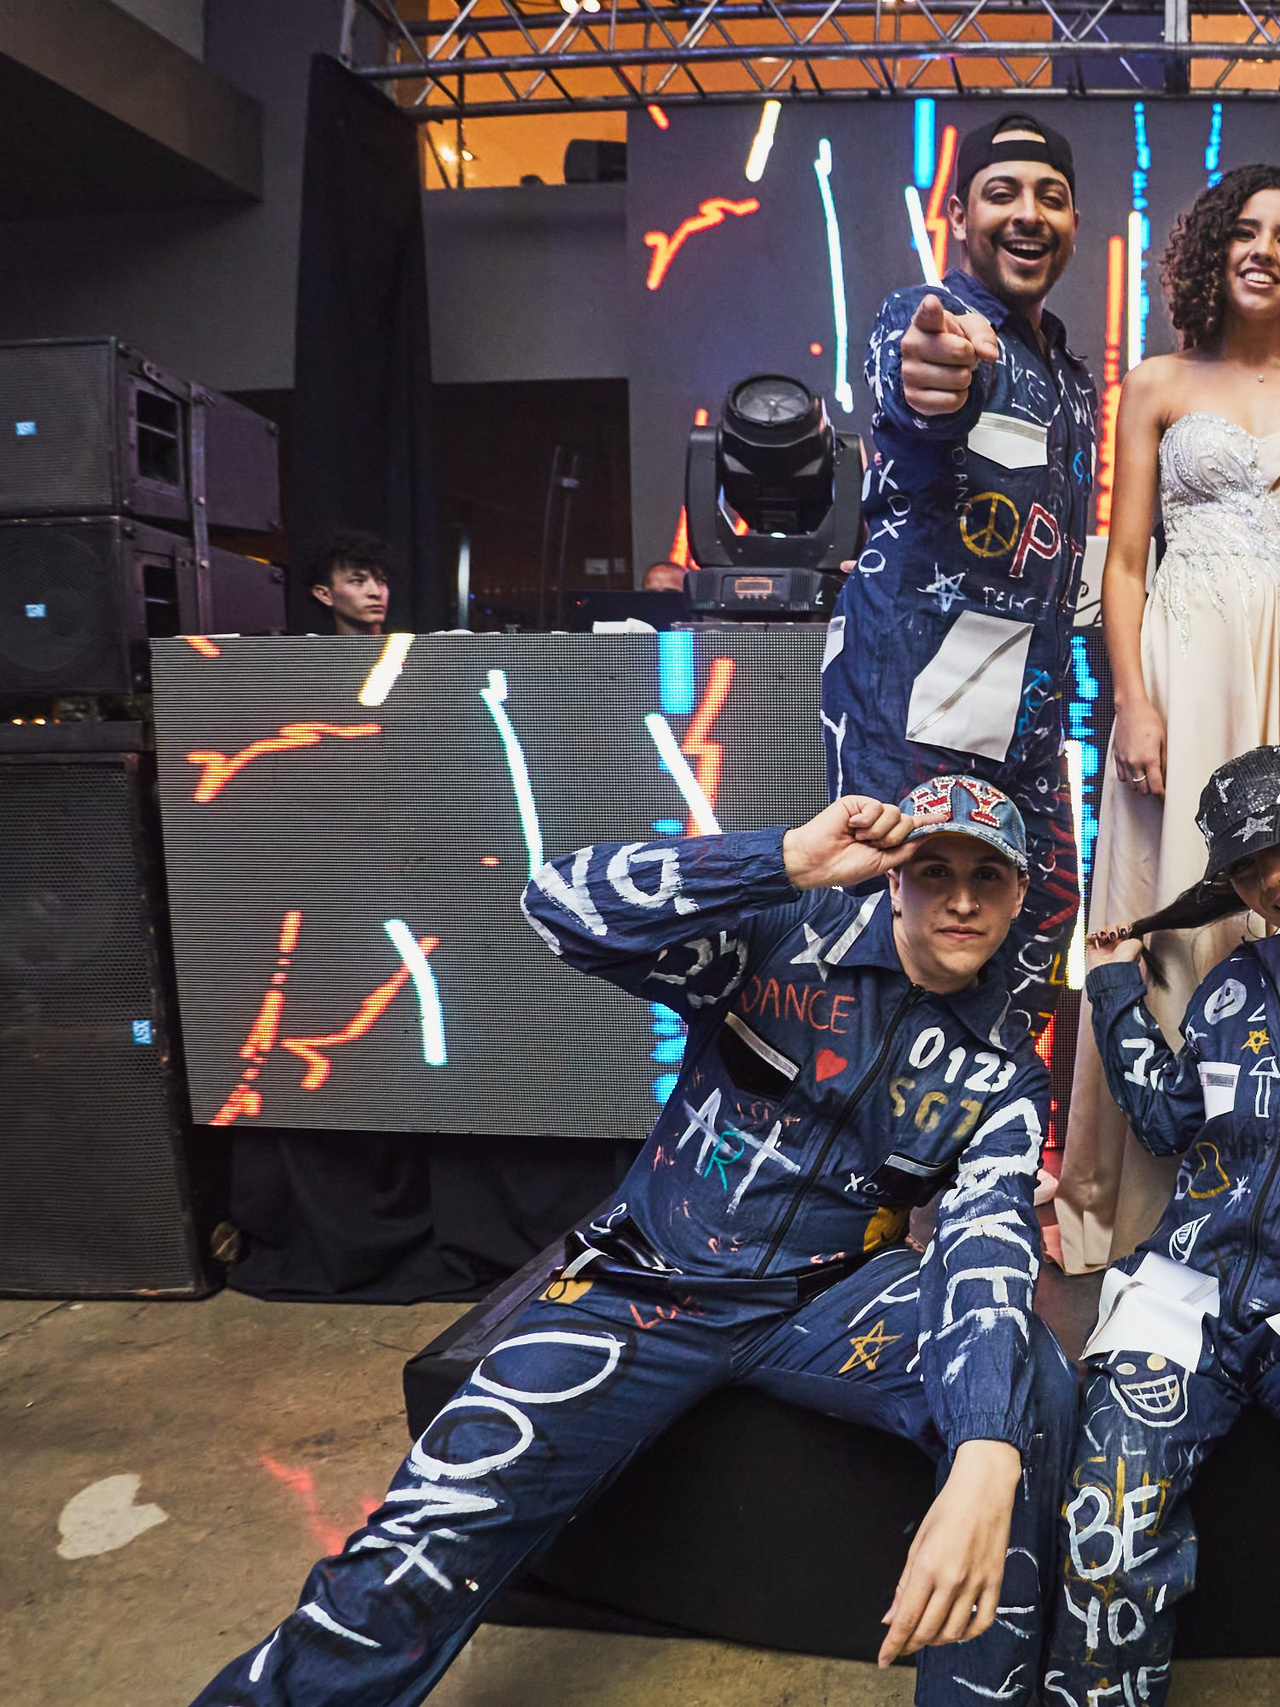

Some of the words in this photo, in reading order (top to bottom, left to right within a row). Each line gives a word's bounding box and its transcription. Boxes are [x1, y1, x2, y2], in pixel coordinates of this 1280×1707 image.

[912, 775, 1008, 829] NY
[741, 974, 856, 1035] DANCE
[908, 1026, 1017, 1093] 0123
[676, 1087, 802, 1216] ART
[1065, 1484, 1160, 1581] BE
